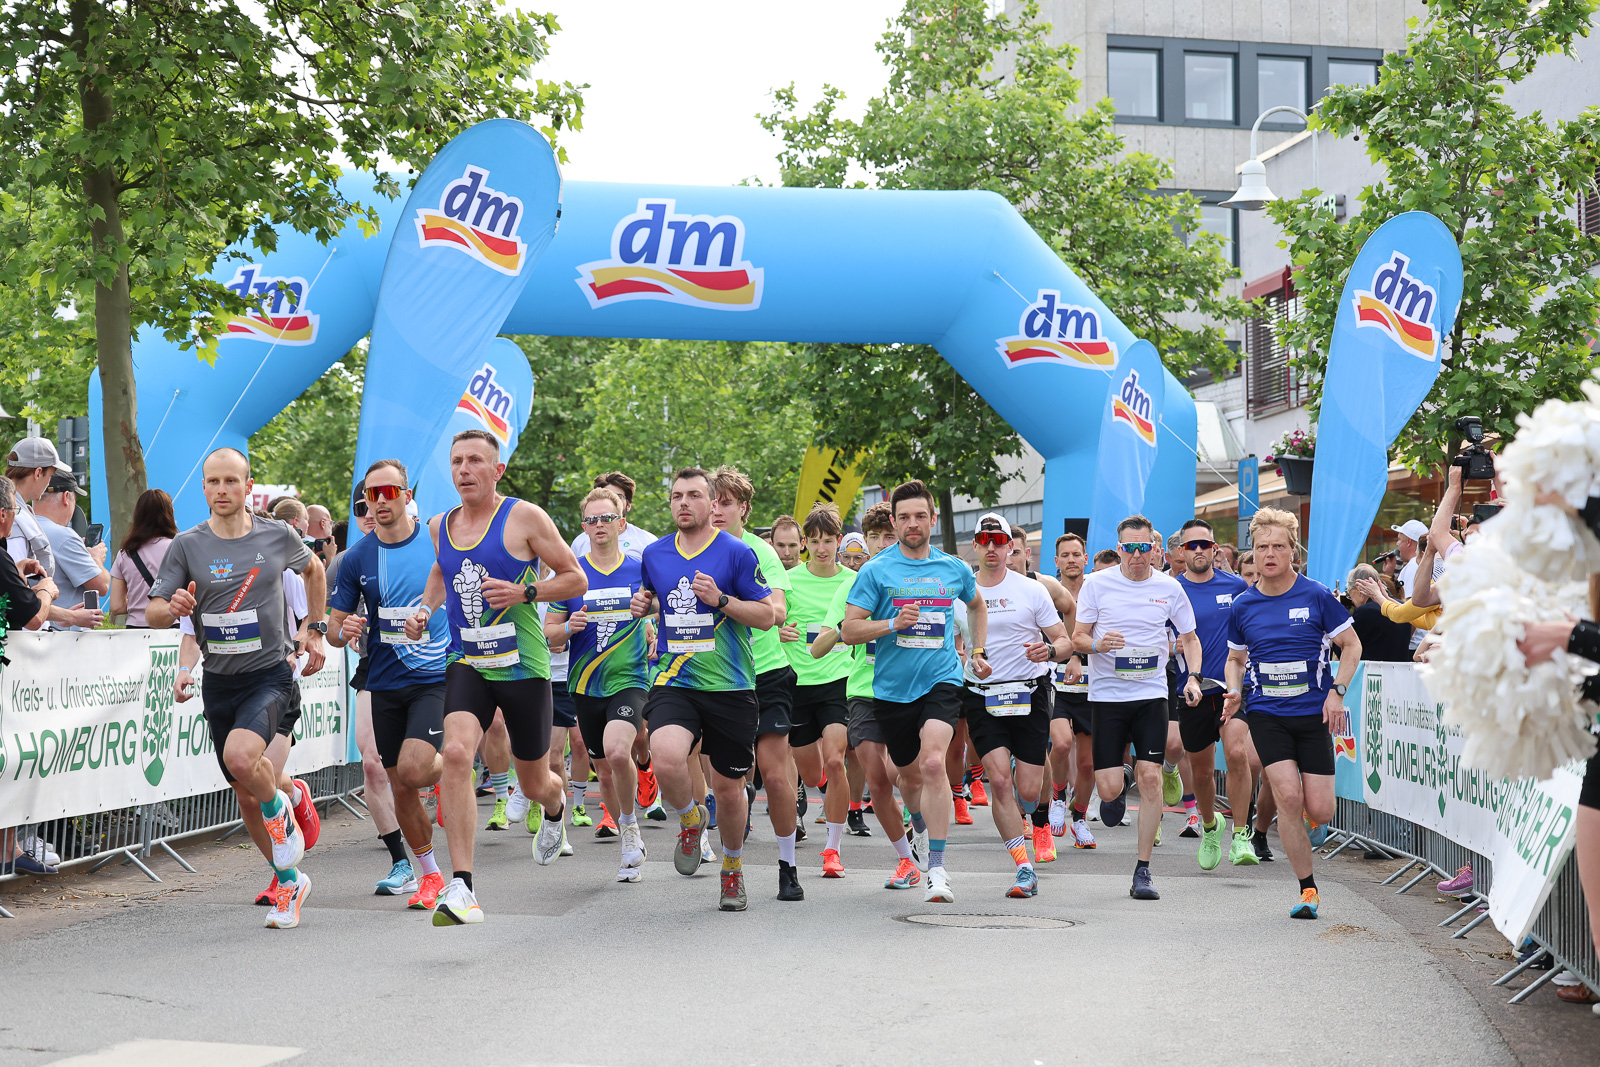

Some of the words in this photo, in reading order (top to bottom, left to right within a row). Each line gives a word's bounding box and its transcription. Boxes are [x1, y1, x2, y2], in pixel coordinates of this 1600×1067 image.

[444, 171, 519, 238] dm
[619, 204, 738, 267] dm
[1374, 256, 1434, 323] dm
[1025, 294, 1097, 339] dm
[470, 370, 511, 417] dm
[1122, 373, 1150, 419] dm
[1243, 466, 1253, 510] P
[595, 598, 620, 606] Sascha
[219, 626, 239, 635] Yves
[476, 641, 499, 650] Marc
[675, 626, 701, 636] Jeremy
[11, 679, 44, 713] Kreis-
[47, 686, 57, 711] u.
[60, 672, 145, 709] Universitätsstadt
[997, 692, 1019, 701] Martin
[1268, 673, 1298, 681] Matthias
[13, 719, 138, 781] HOMBURG
[1387, 738, 1437, 791] HOMBURG
